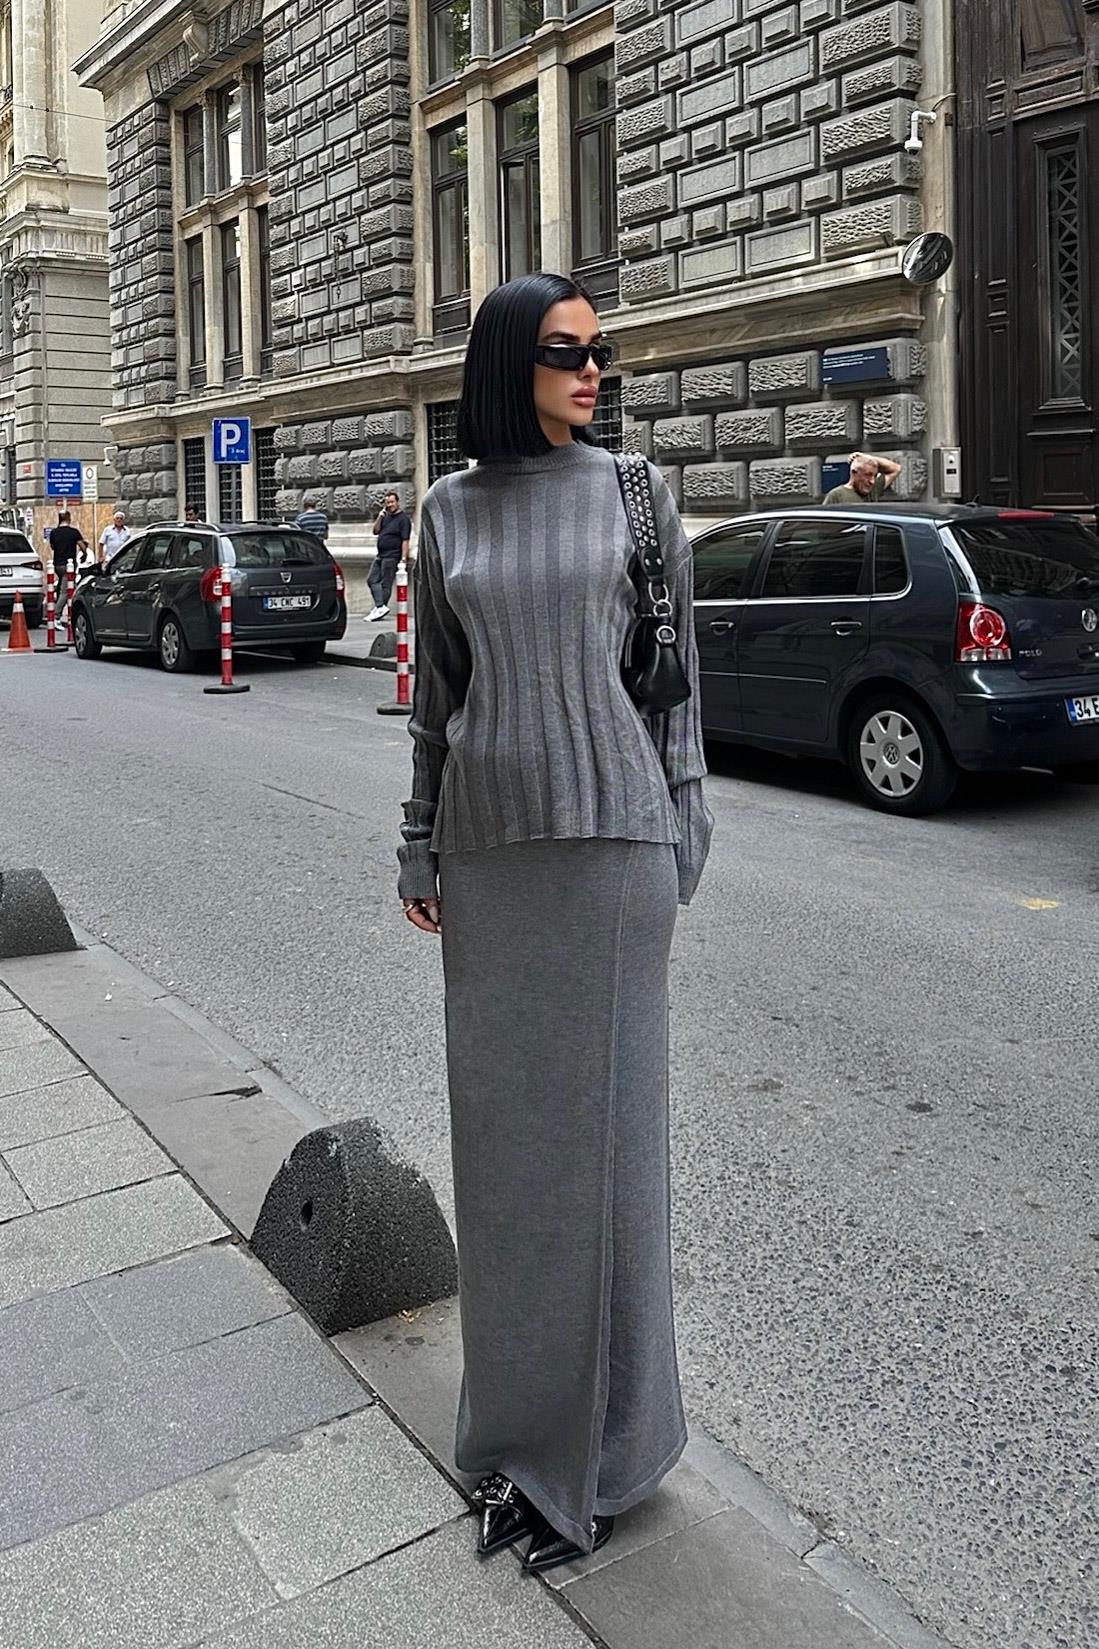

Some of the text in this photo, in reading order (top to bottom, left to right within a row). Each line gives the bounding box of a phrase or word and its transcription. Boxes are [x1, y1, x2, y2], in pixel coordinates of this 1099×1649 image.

[221, 423, 241, 457] P
[268, 598, 278, 607] 34
[1075, 698, 1091, 717] 34
